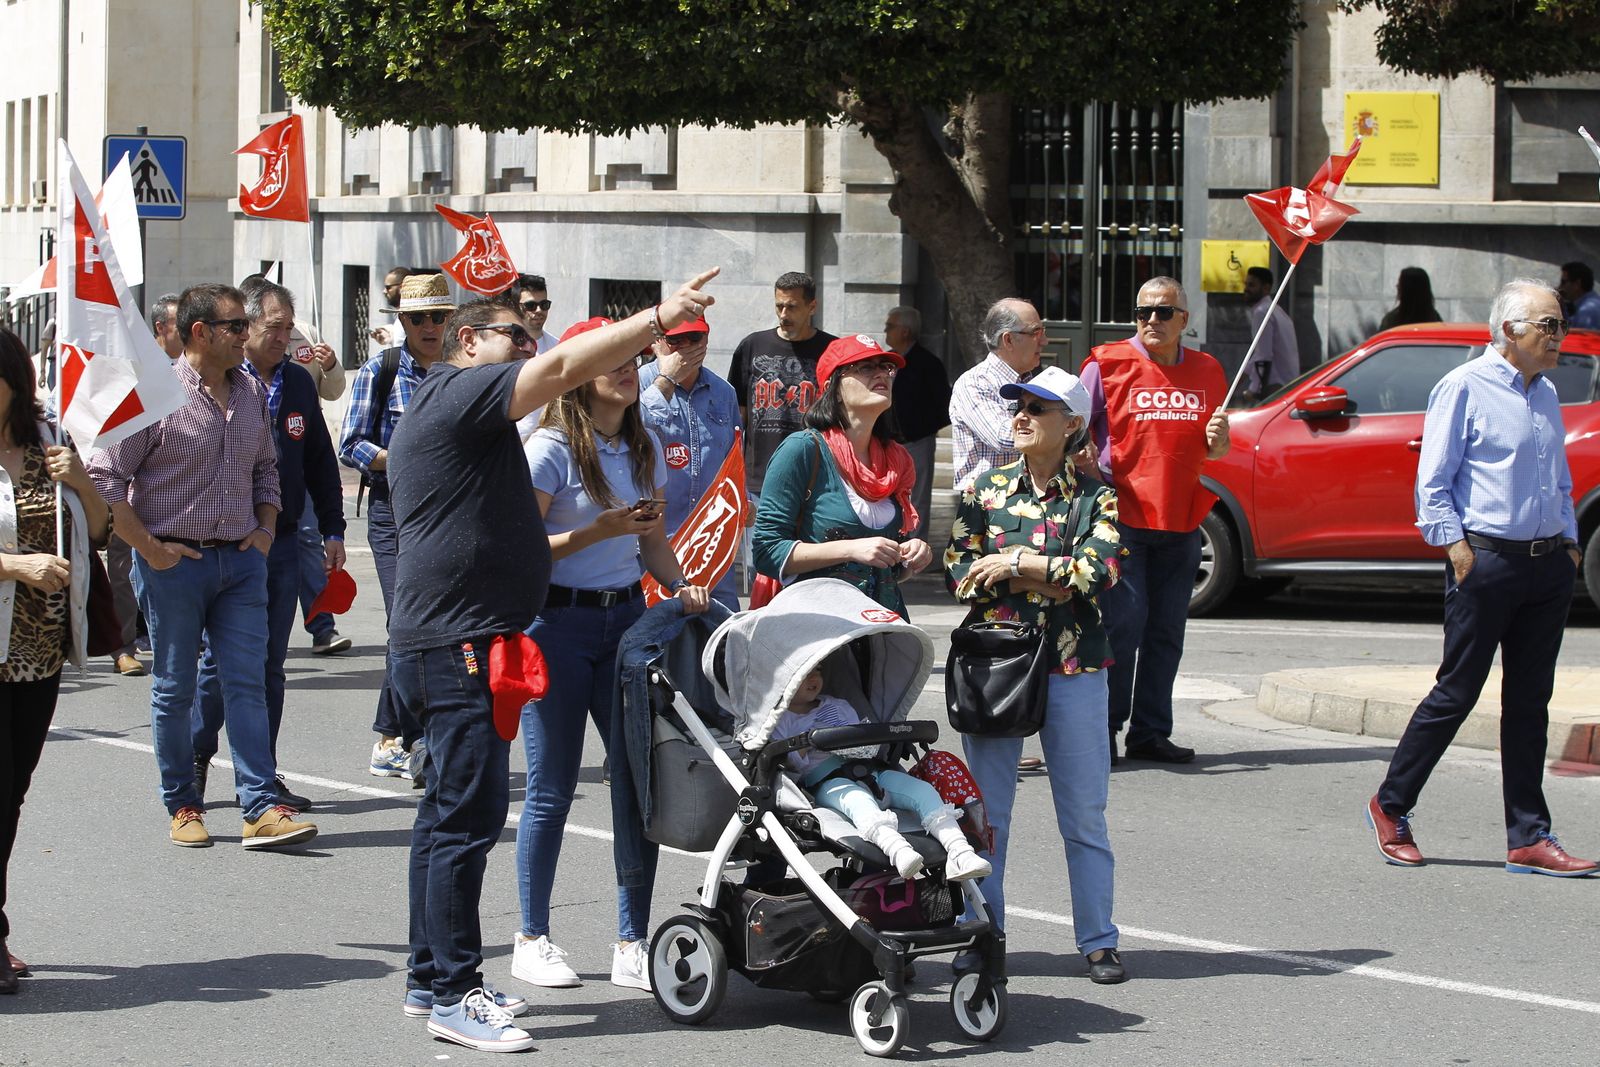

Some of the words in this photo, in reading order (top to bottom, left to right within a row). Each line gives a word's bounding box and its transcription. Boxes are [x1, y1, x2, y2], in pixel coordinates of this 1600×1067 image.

[288, 415, 303, 428] UGT
[1135, 410, 1199, 421] andalucía
[666, 446, 685, 459] UGT
